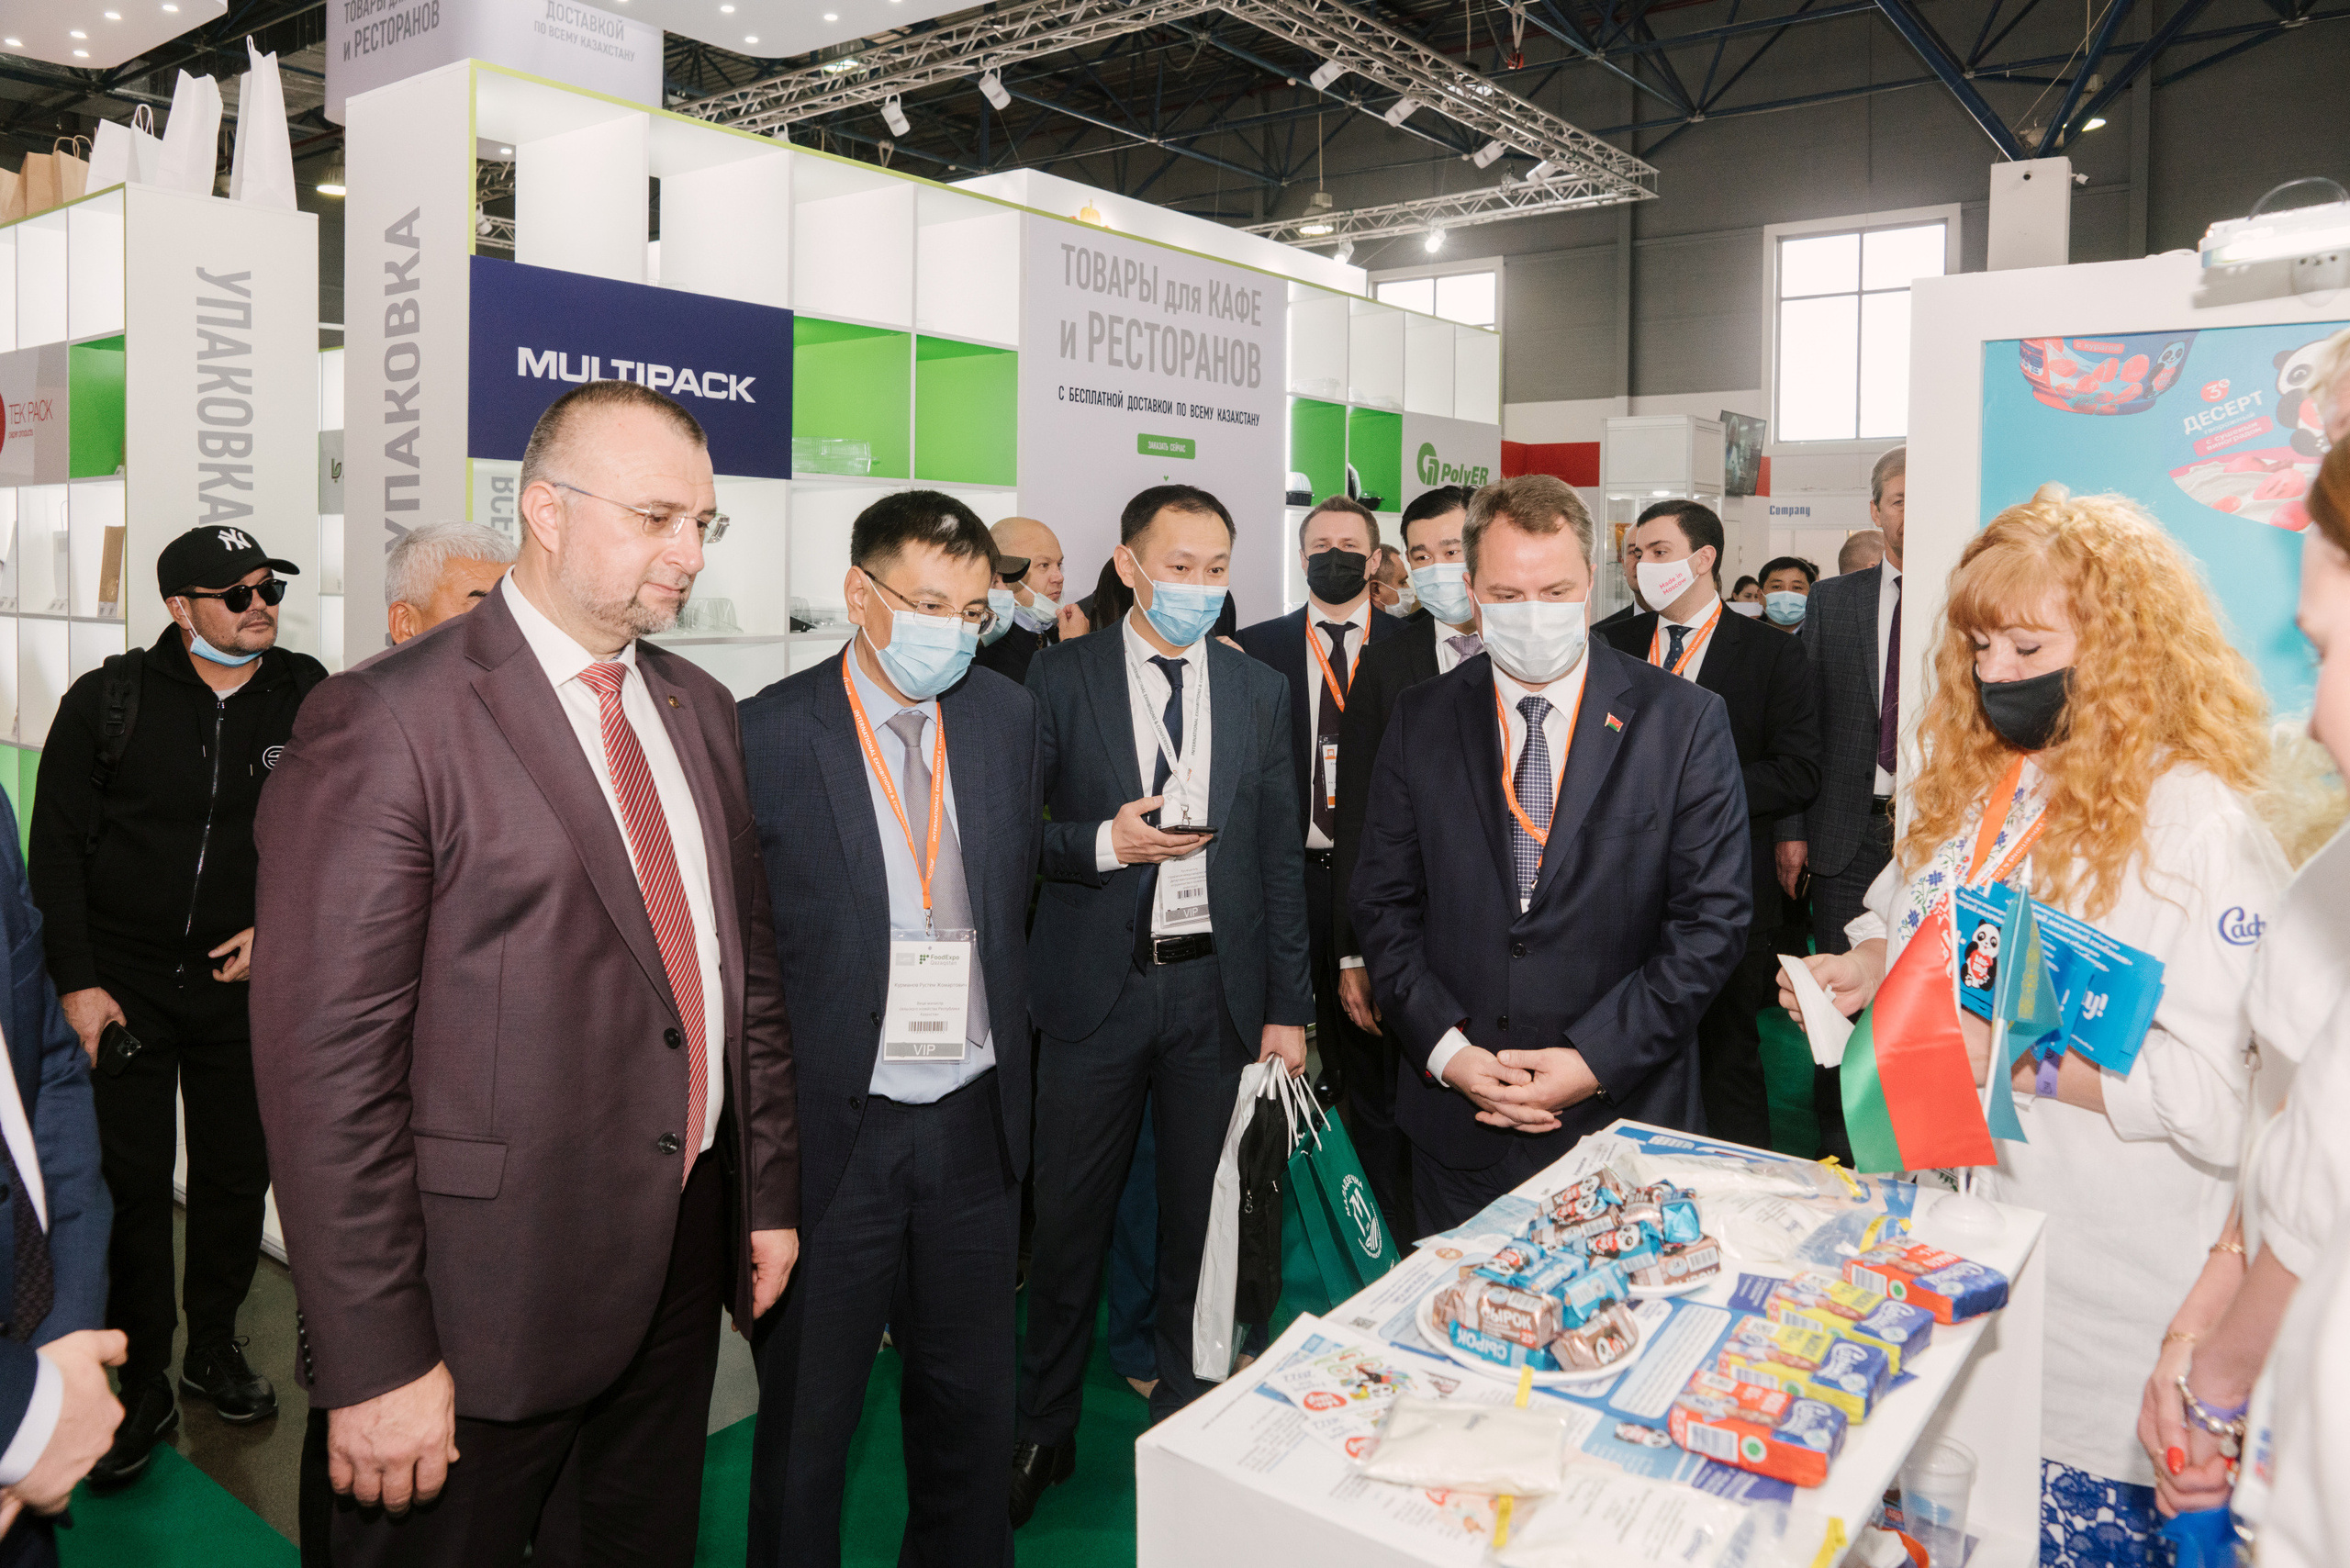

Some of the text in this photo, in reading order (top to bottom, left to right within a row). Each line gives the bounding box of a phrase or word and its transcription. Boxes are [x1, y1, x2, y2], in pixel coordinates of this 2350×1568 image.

[354, 0, 440, 58] РЕСТОРАНОВ
[546, 0, 624, 40] ДОСТАВКОЙ
[534, 20, 635, 62] ПО ВСЕМУ КАЗАХСТАНУ
[1060, 243, 1262, 327] ТОВАРЫ для КАФЕ
[1059, 310, 1262, 389] и РЕСТОРАНОВ
[518, 346, 756, 404] MULTIPACK
[9, 398, 53, 425] TEK PACK
[196, 266, 254, 525] УПАКОВКА
[1058, 386, 1065, 400] С
[1069, 386, 1124, 409] БЕСПЛАТНОЙ
[1176, 402, 1187, 417] ПО
[1191, 404, 1214, 420] ВСЕМУ
[1217, 409, 1260, 427] КАЗАХСТАНУ
[2183, 389, 2263, 435] ДЕСЕРТ
[2206, 426, 2263, 452] виноградом
[1440, 463, 1489, 487] PolyER
[1769, 505, 1811, 518] Company
[1659, 577, 1676, 589] Made
[1662, 577, 1686, 595] Moscow
[854, 709, 877, 757] INTERNATIONAL
[873, 757, 894, 794] EXHIBITIONS
[932, 793, 940, 843] INTERNATIONAL
[1183, 907, 1199, 918] VIP
[913, 1044, 936, 1056] VIP
[1480, 1305, 1532, 1331] СЫРОК
[1457, 1327, 1508, 1361] СЫРОК
